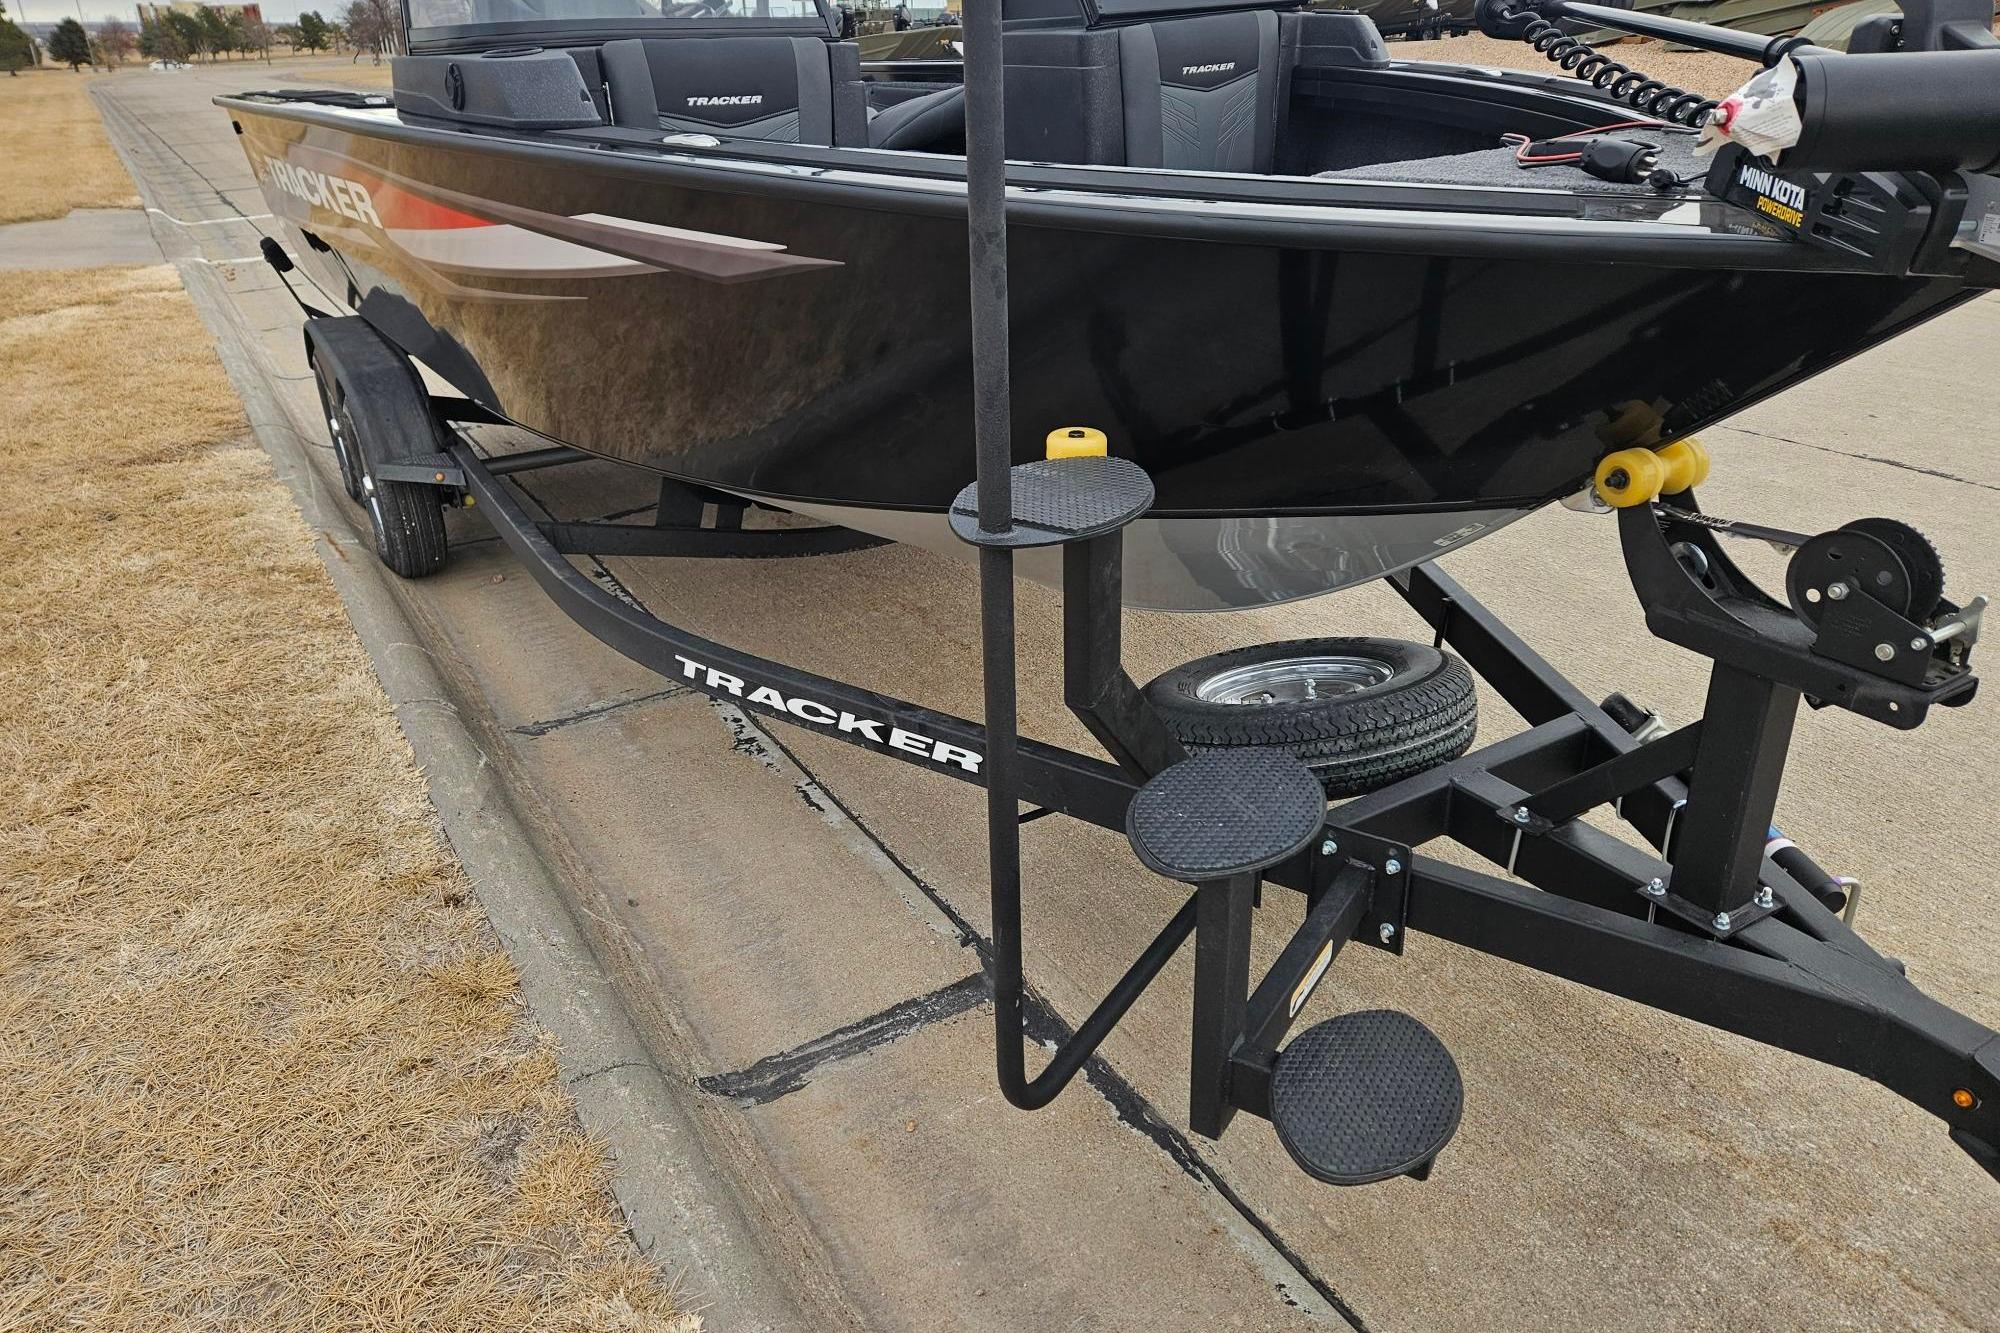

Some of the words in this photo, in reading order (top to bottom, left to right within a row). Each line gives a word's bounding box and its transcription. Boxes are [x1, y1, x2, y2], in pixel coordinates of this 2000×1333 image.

[1182, 62, 1236, 76] TRACKER
[686, 95, 763, 107] TRACKER
[263, 155, 384, 229] TRACKER
[1739, 164, 1774, 196] MINN
[1771, 177, 1805, 210] KOTA
[1756, 195, 1804, 228] POWERDRIVE
[674, 654, 984, 774] TRACKER
